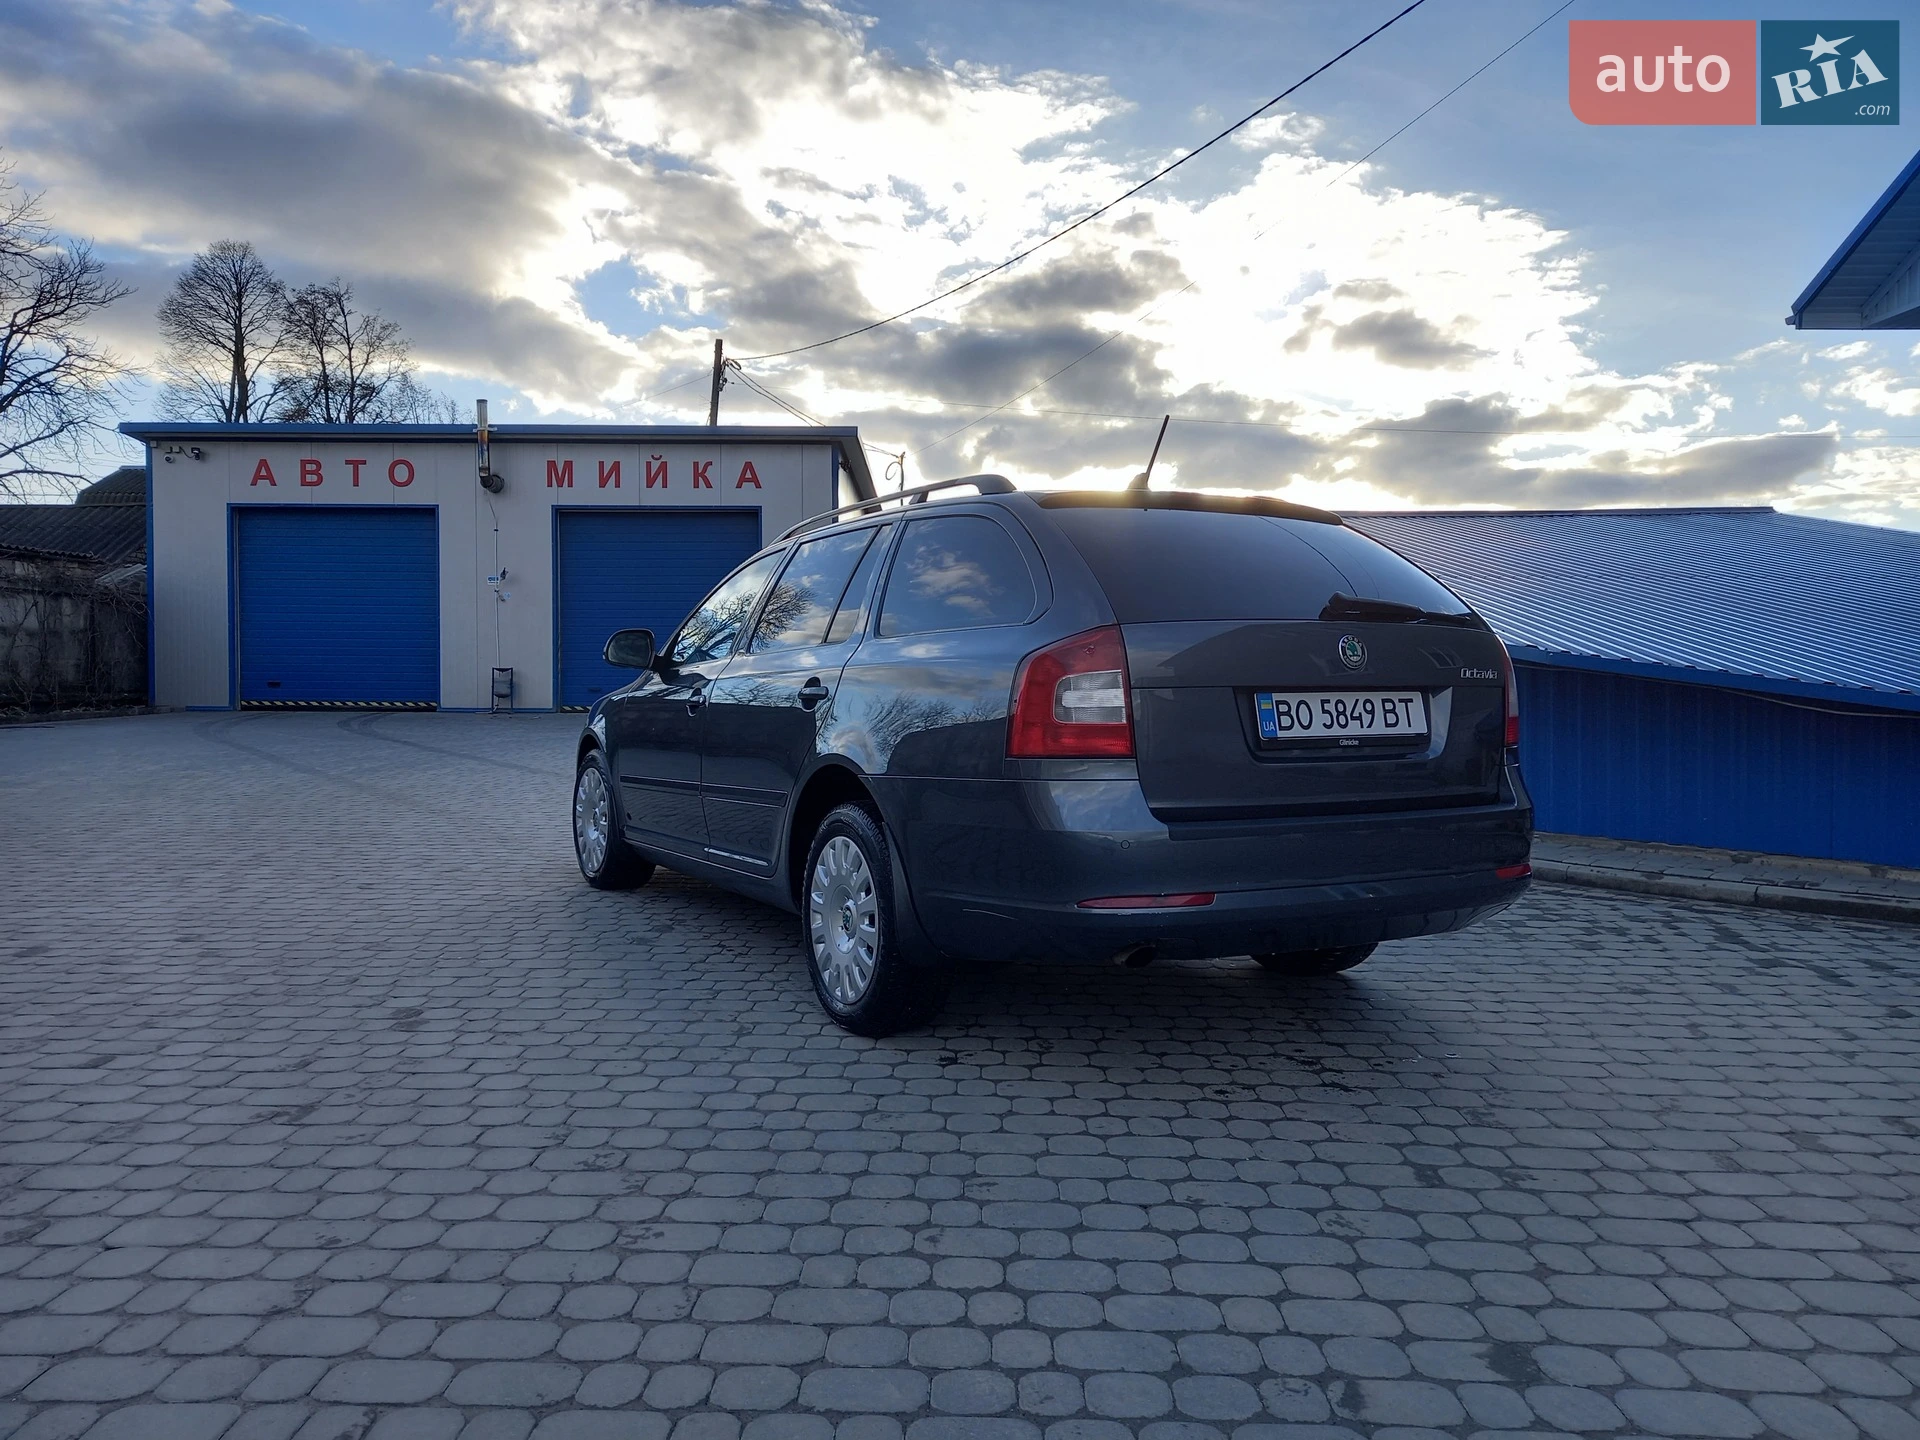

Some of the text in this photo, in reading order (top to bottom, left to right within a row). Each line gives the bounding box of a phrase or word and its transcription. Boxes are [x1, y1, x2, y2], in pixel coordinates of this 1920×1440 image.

[250, 454, 762, 489] АВТО МИЙКА
[1460, 667, 1498, 679] Octavia
[1320, 698, 1376, 730] 5849
[1263, 721, 1276, 732] UA
